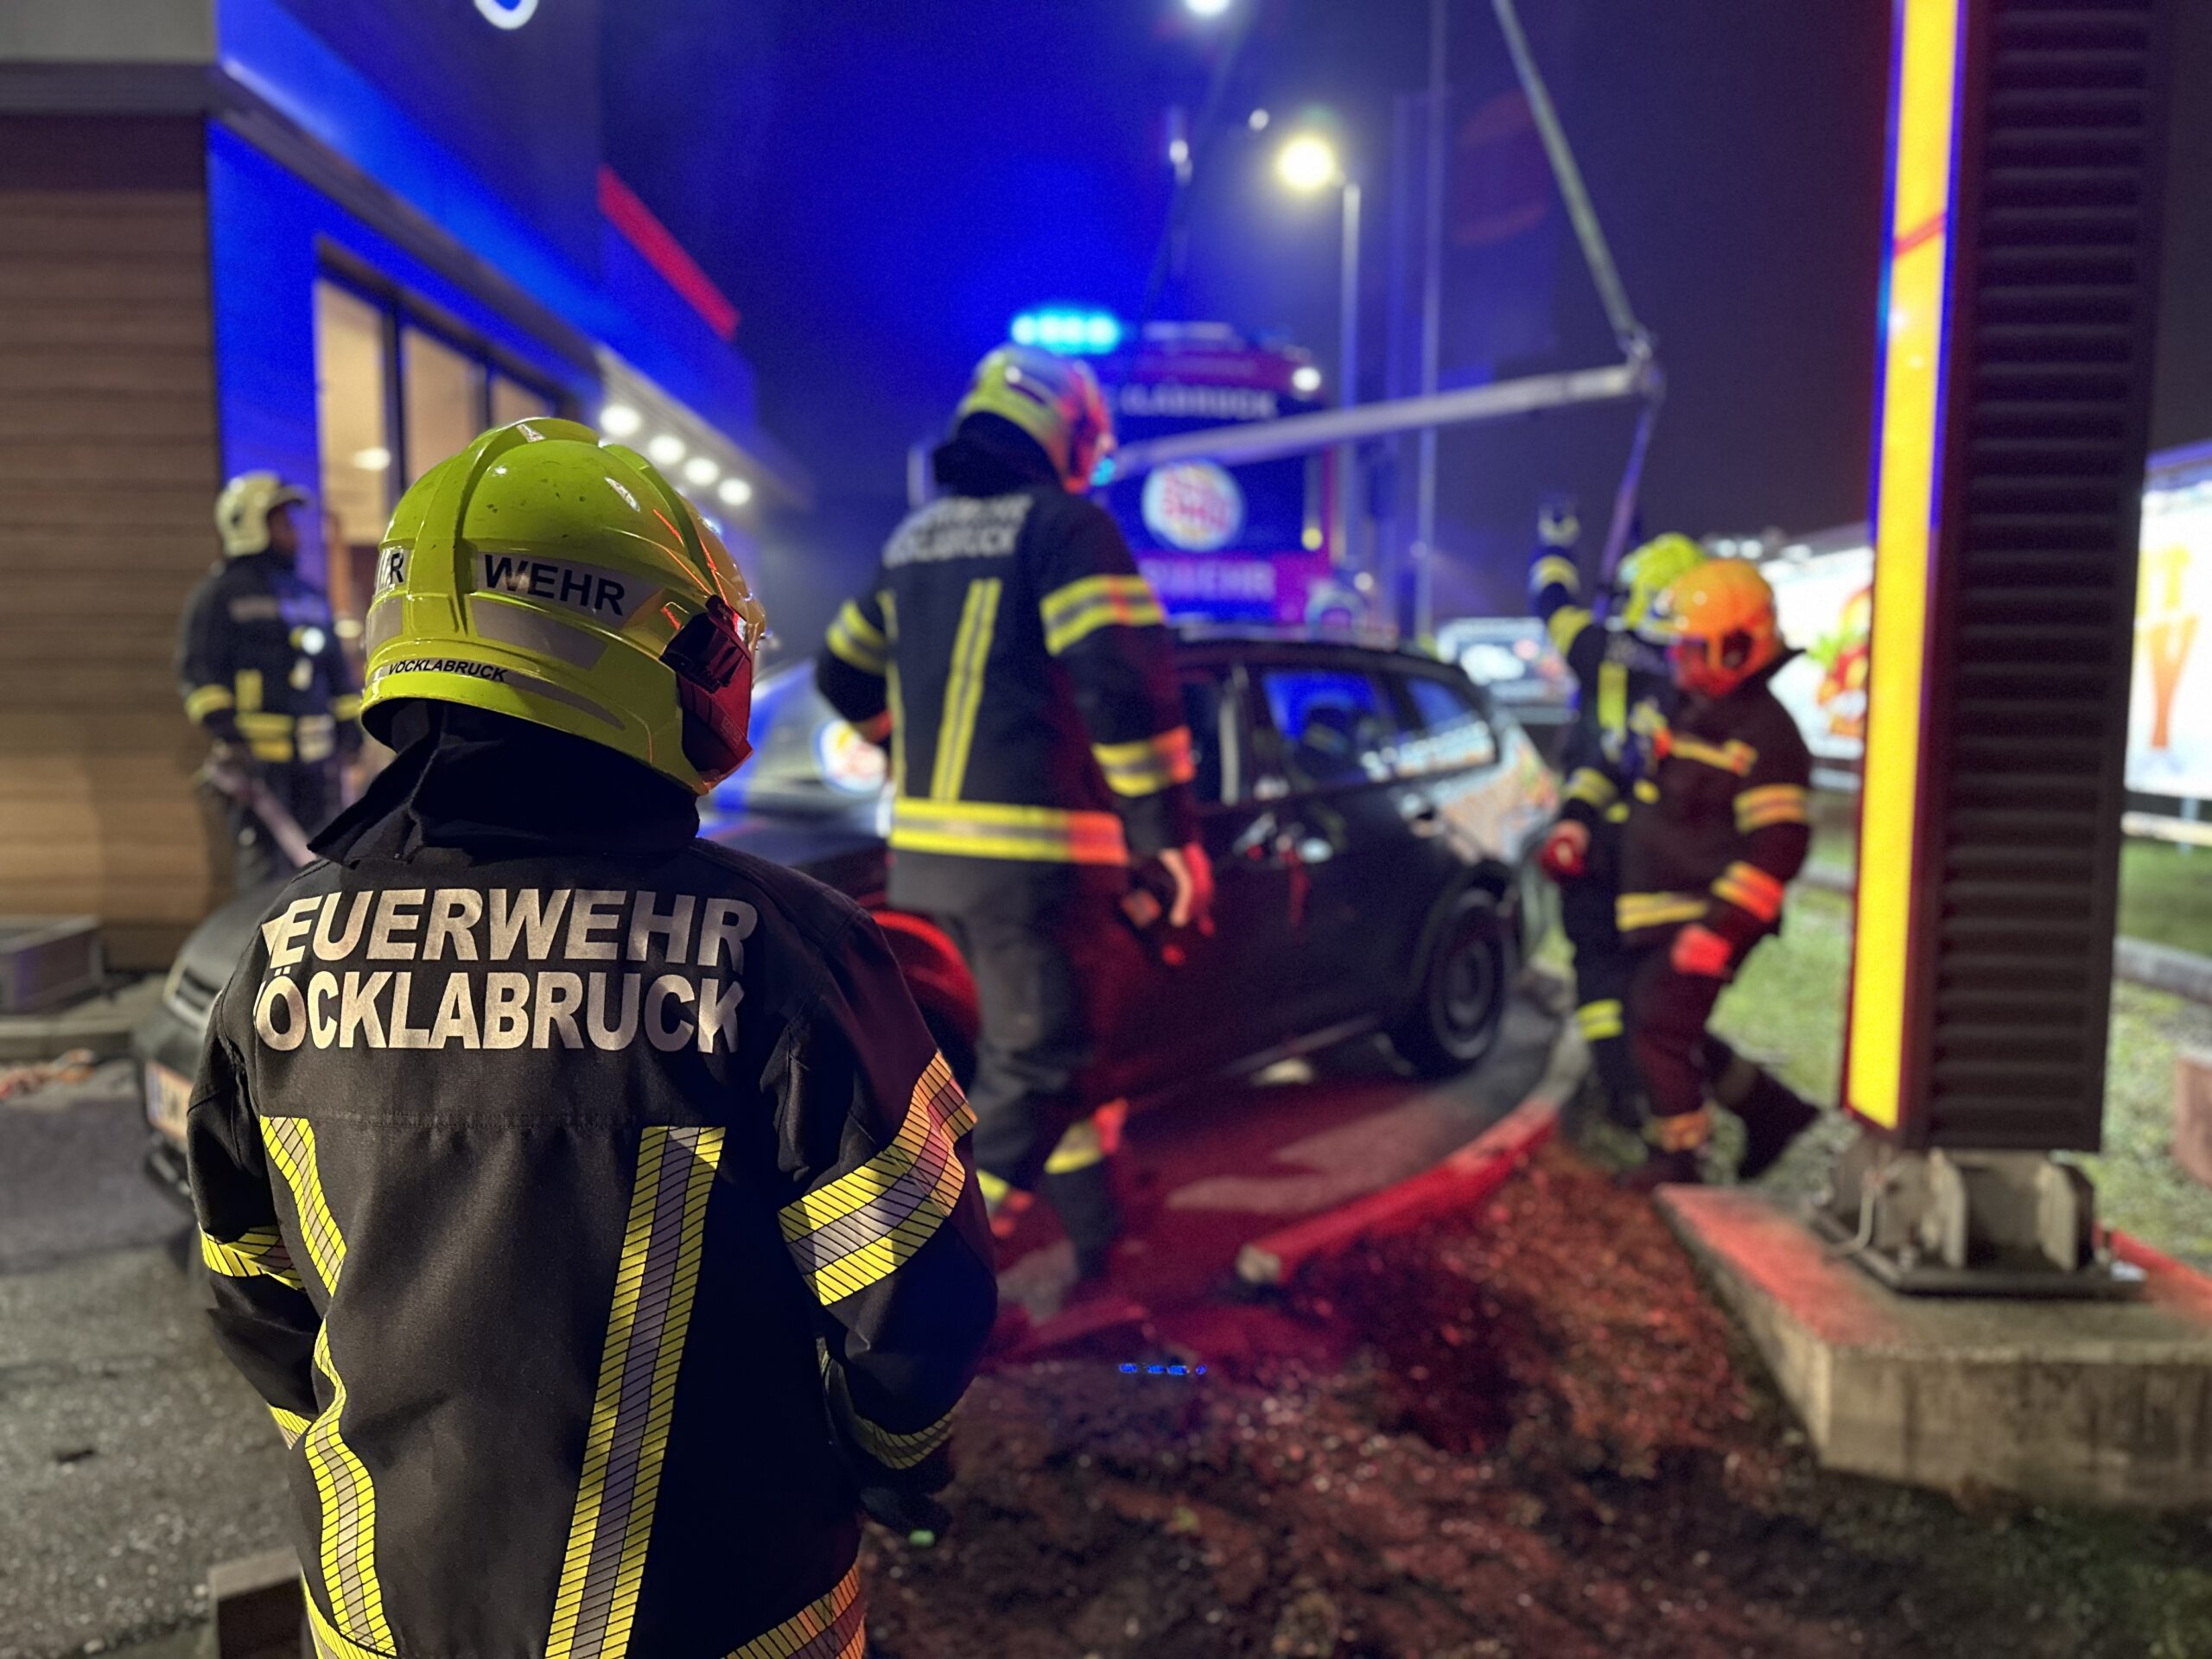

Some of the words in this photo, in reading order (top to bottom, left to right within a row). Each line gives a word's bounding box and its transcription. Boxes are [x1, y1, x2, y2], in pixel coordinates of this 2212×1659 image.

[485, 554, 626, 616] WEHR
[262, 888, 758, 975] EUERWEHR
[253, 966, 745, 1054] ÖCKLABRUCK
